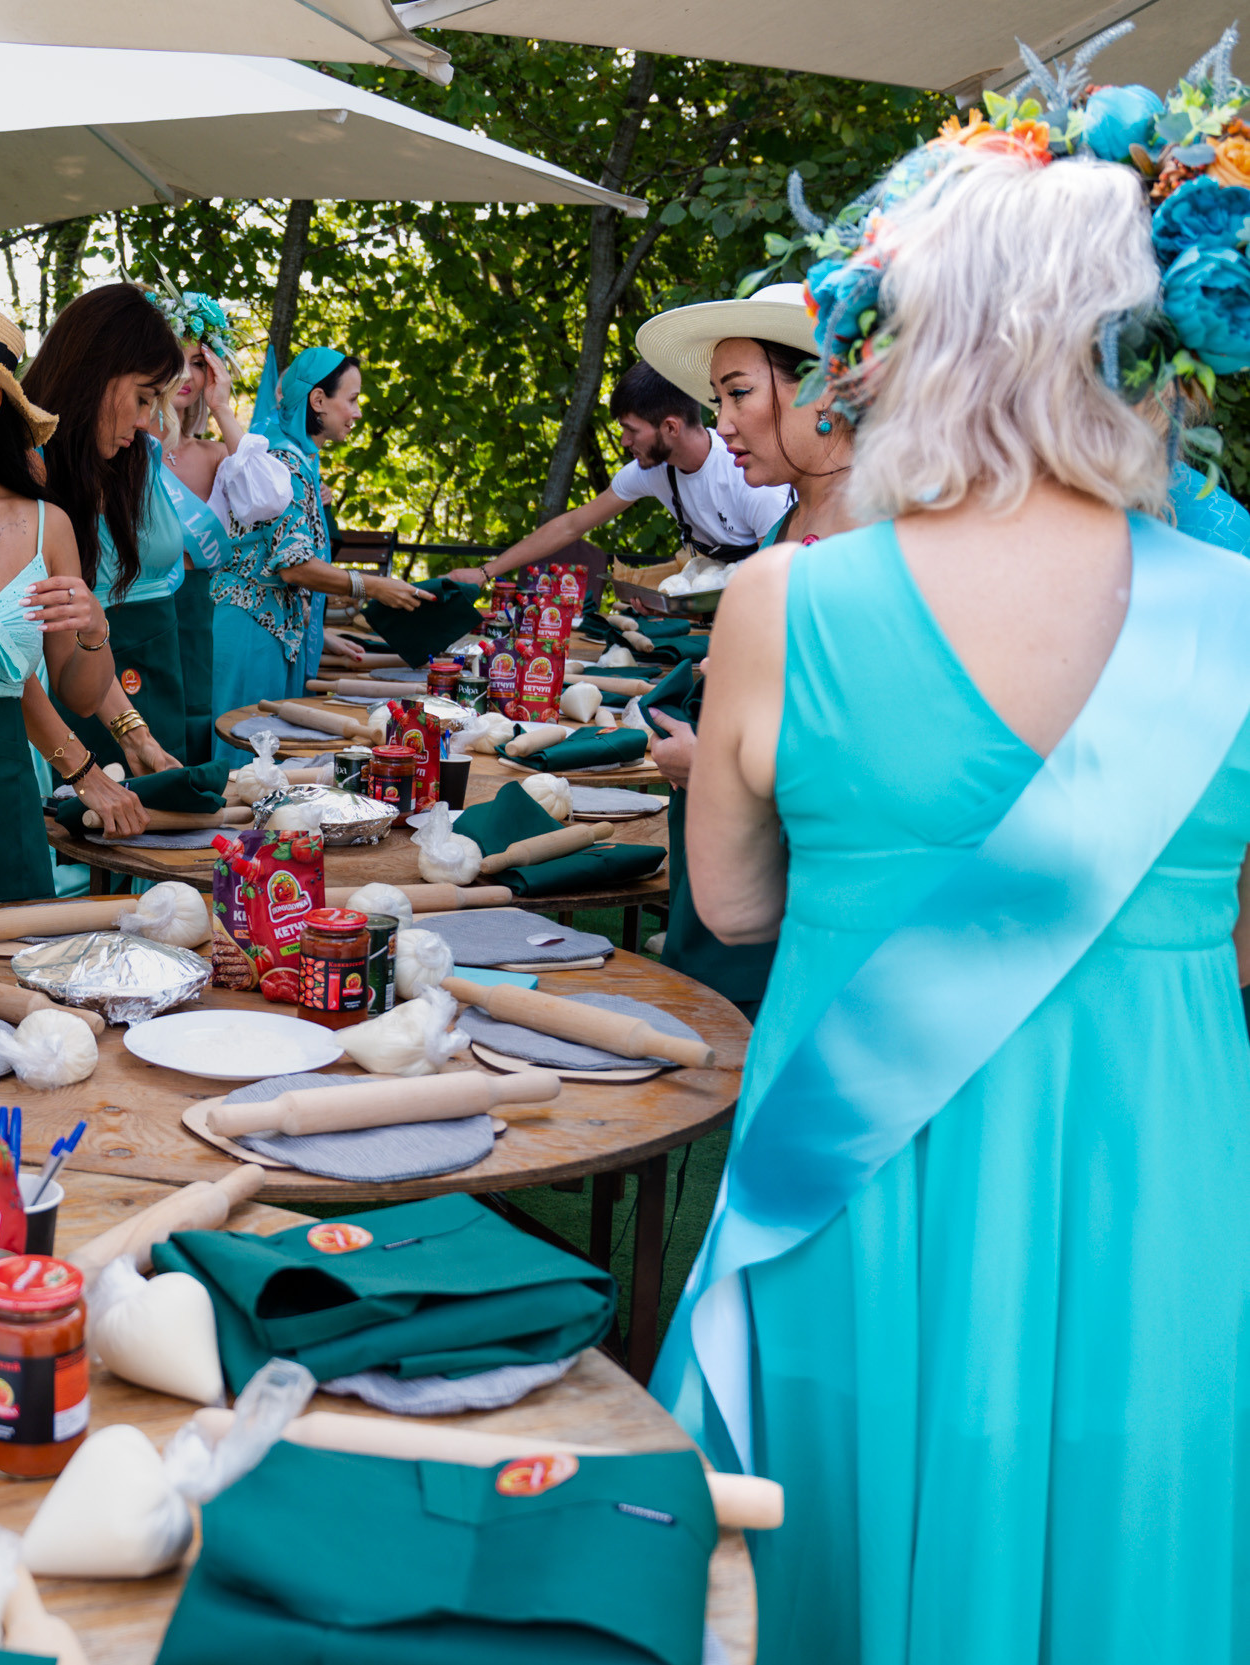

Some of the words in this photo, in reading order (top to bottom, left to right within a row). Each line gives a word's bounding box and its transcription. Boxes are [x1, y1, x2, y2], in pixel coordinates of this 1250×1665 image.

[184, 512, 222, 569] LADY
[458, 684, 479, 695] Polpa
[523, 685, 551, 693] КЕТЧУП
